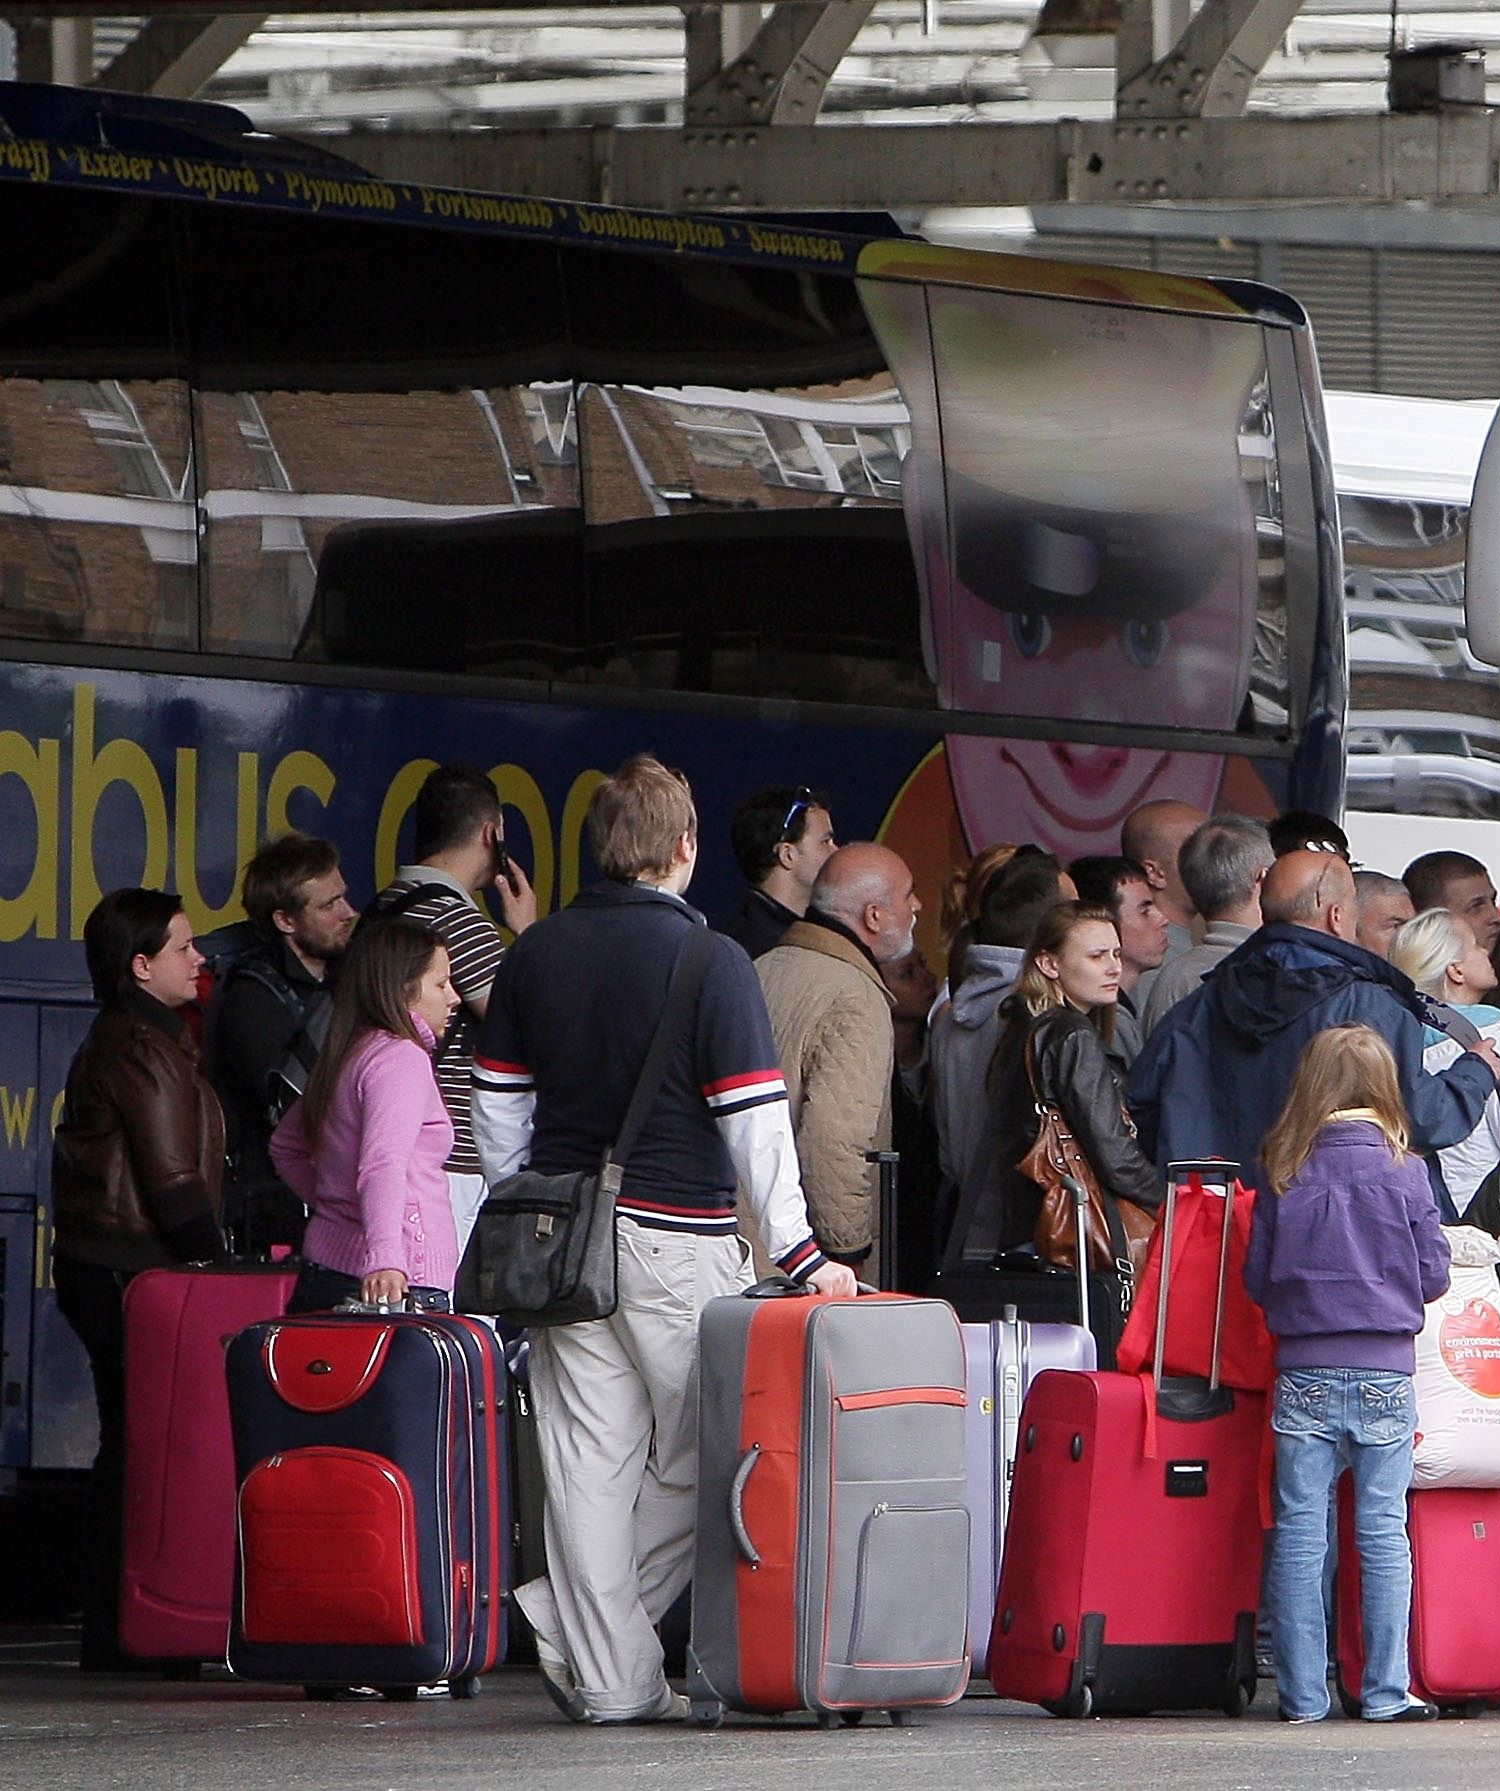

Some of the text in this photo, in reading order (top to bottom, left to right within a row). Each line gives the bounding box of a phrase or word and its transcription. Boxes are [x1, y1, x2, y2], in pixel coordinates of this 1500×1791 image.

[77, 147, 153, 180] Exeter
[174, 156, 260, 199] Oxford
[284, 170, 396, 212] Plymouth
[420, 186, 553, 227] Portsmouth
[575, 206, 725, 252] Southampton
[751, 225, 844, 262] Swansea
